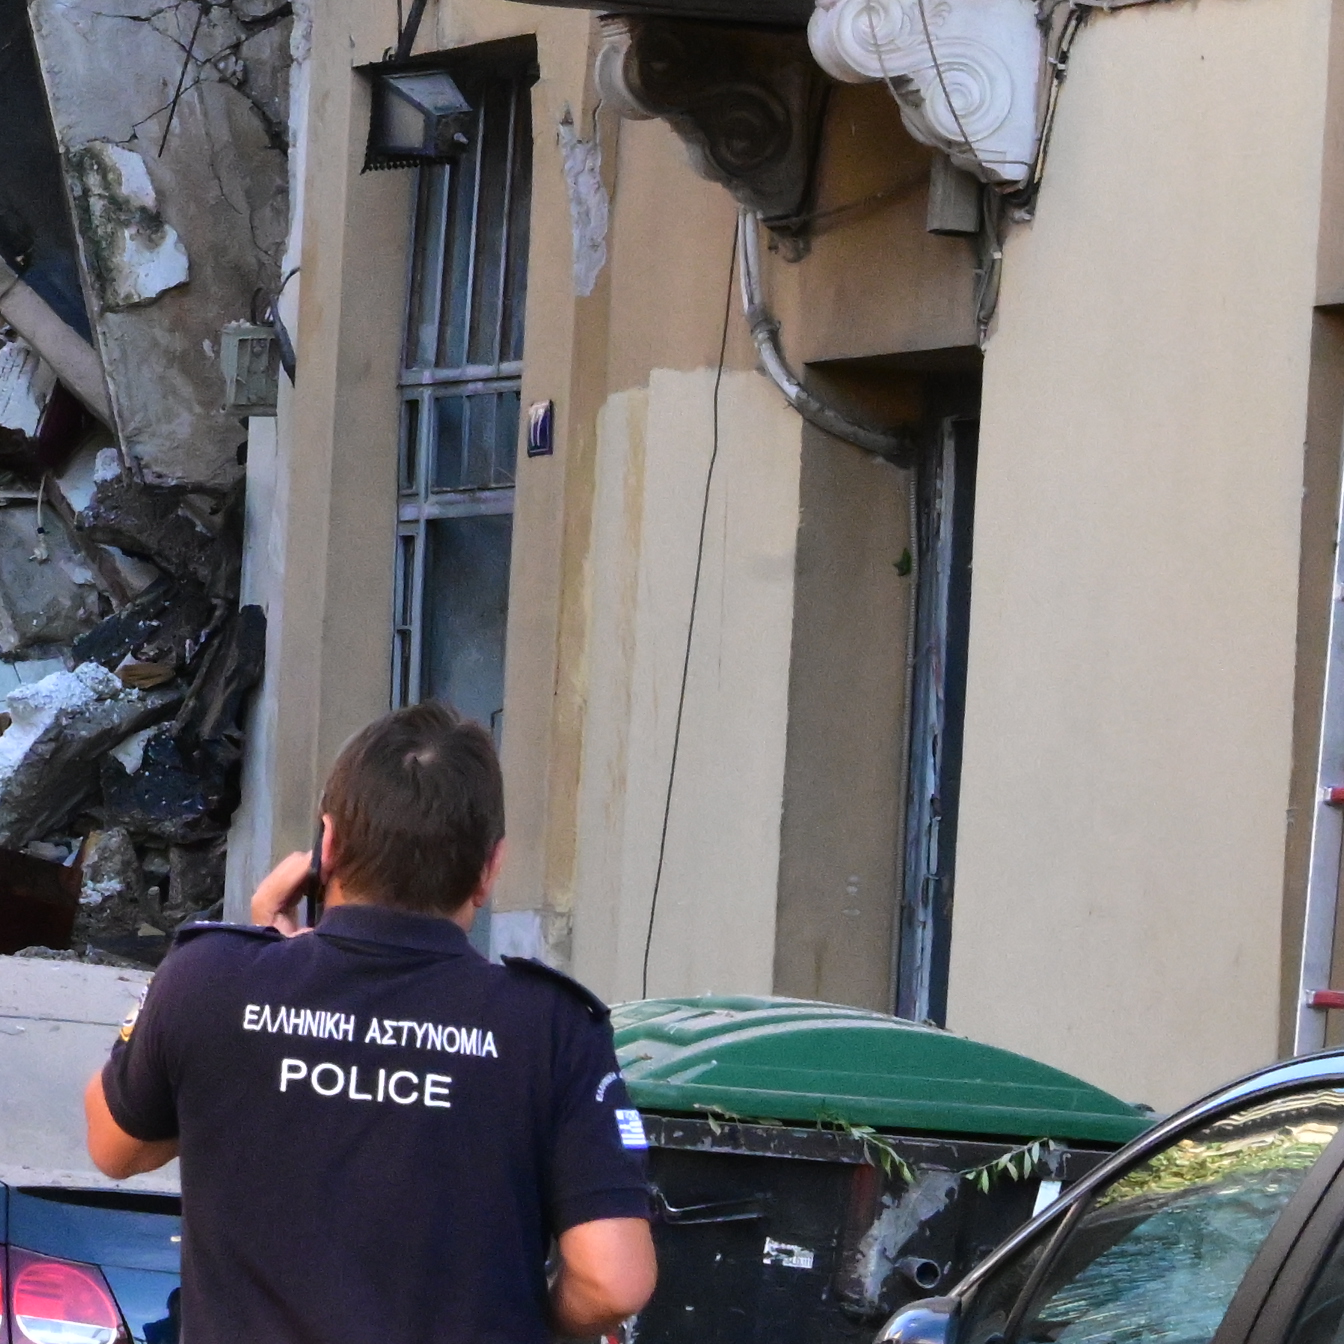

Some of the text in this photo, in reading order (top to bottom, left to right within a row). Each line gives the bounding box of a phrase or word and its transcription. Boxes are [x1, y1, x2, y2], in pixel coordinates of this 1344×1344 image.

[243, 1004, 499, 1058] ΕΛΛΗΝΙΚΗ ΑΣΤΥΝΟΜΙΑ
[279, 1058, 452, 1108] POLICE
